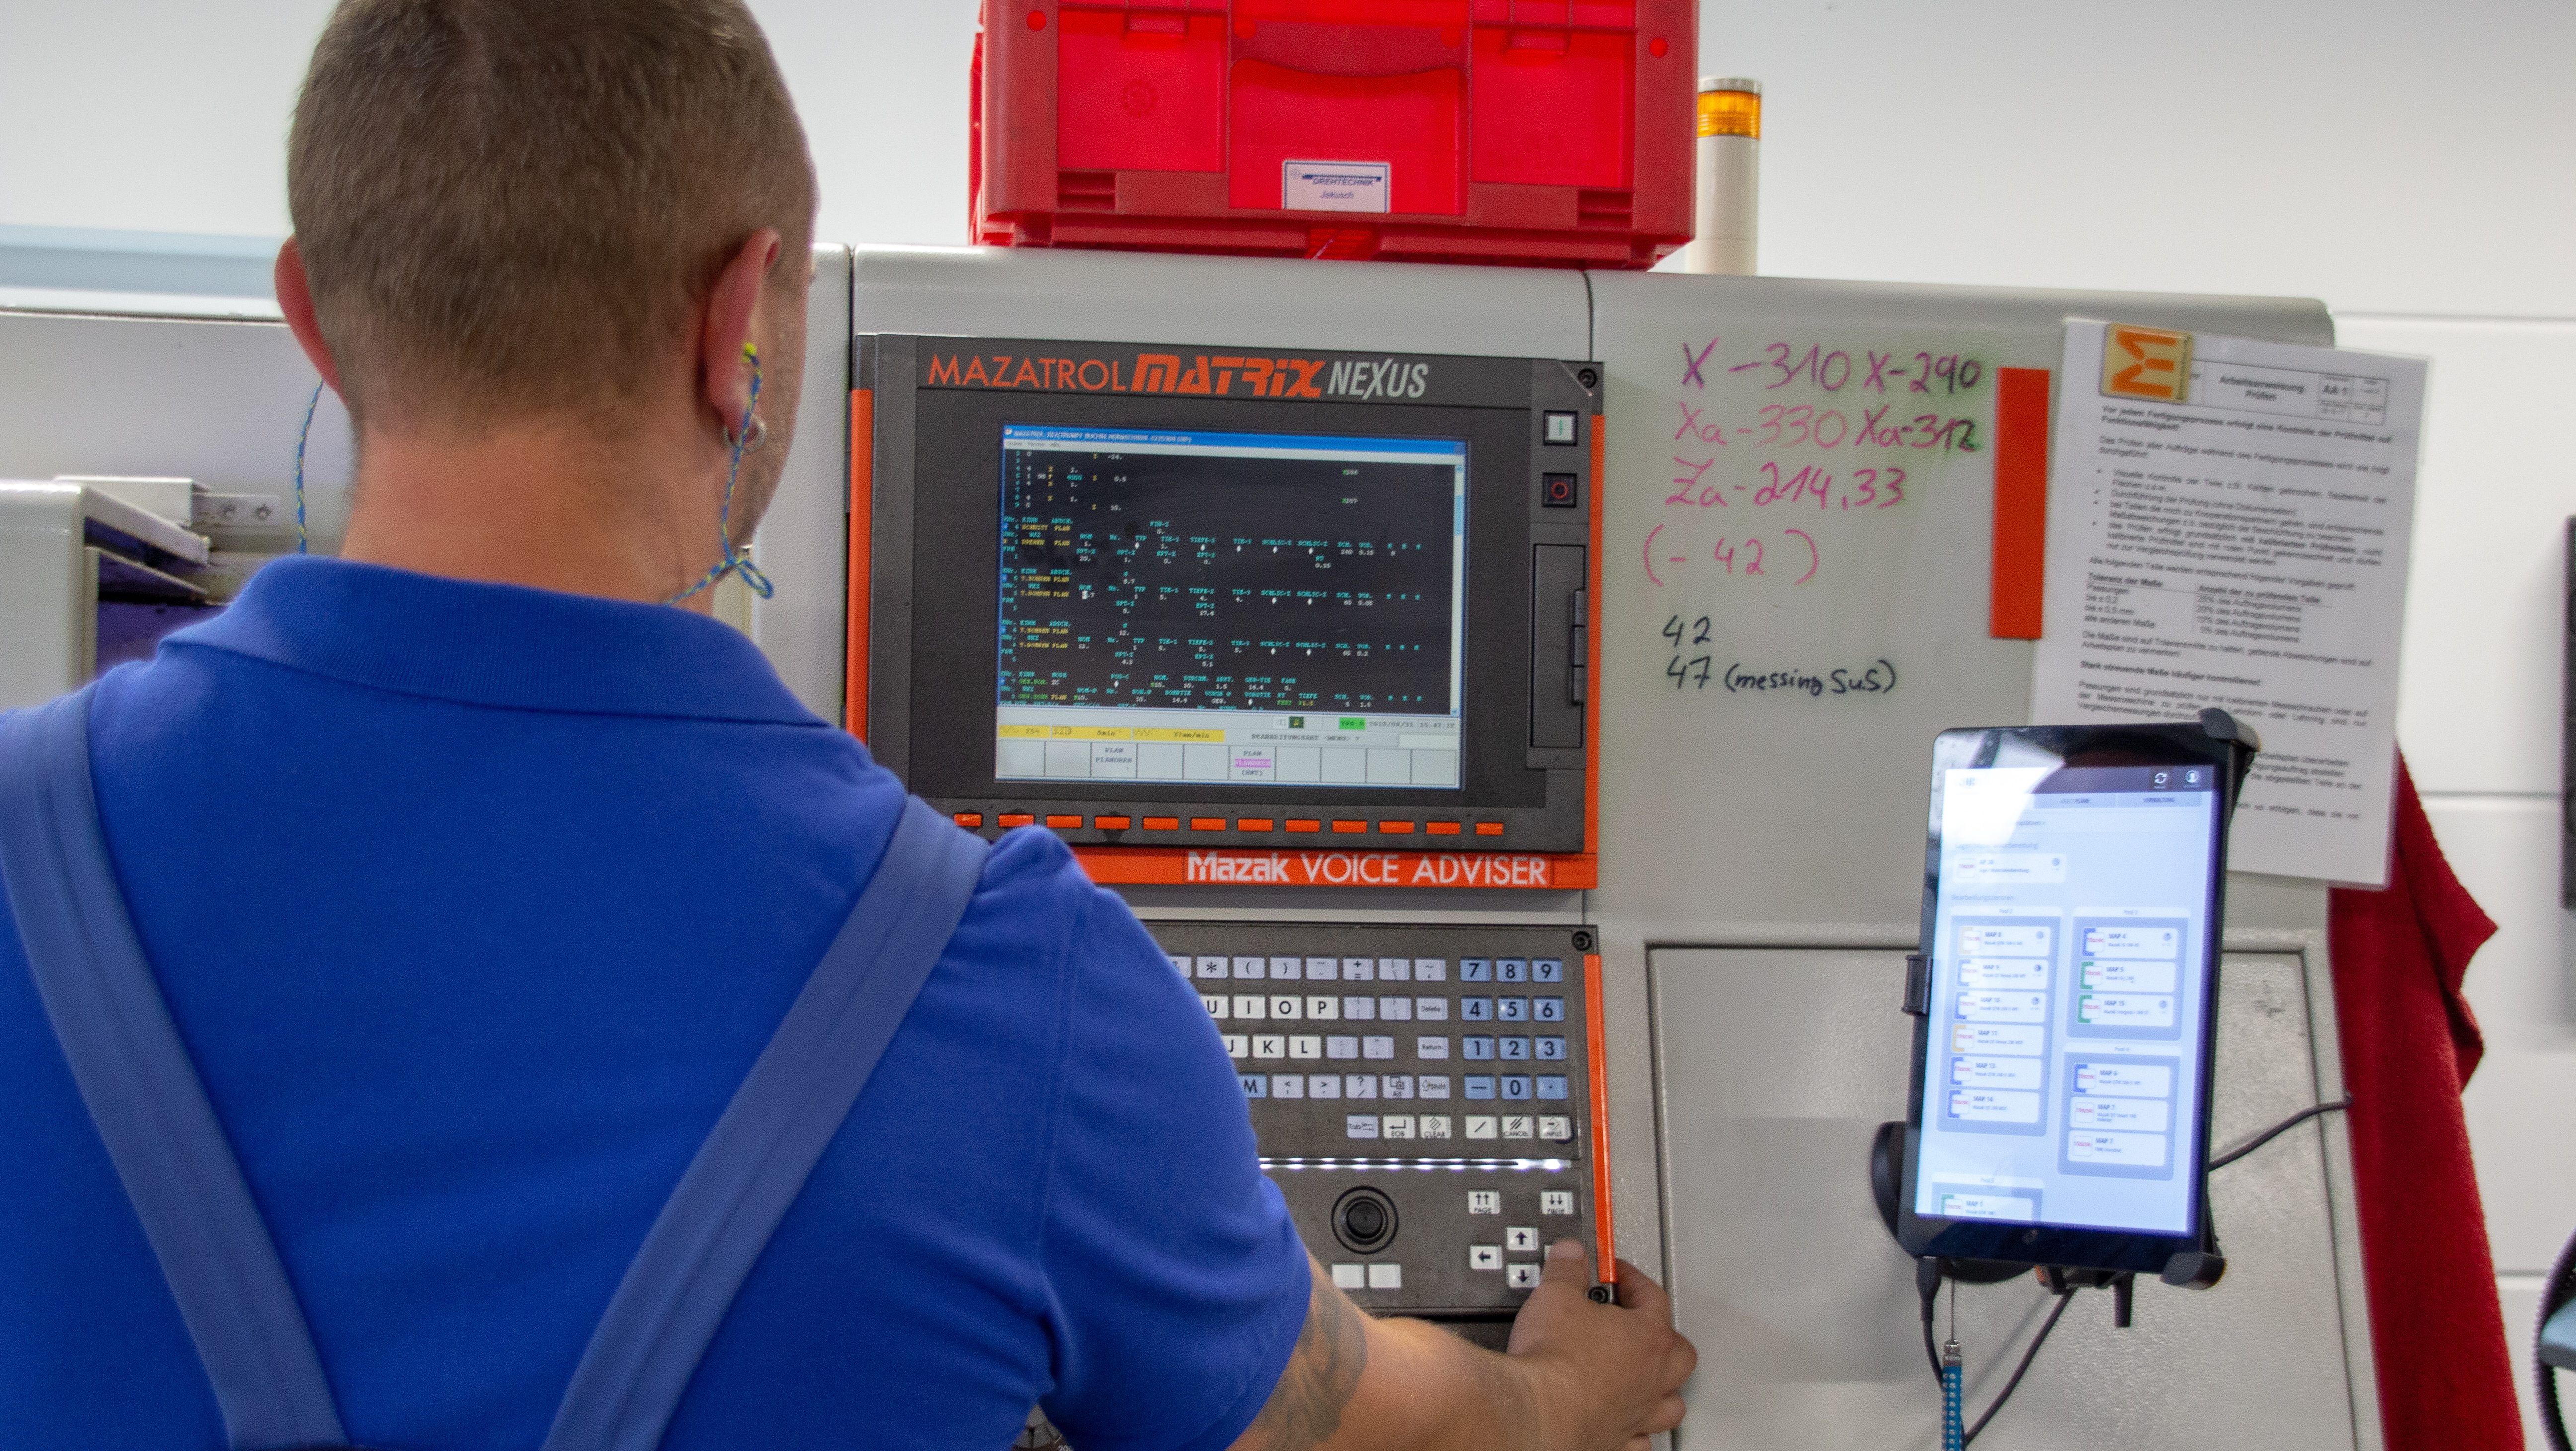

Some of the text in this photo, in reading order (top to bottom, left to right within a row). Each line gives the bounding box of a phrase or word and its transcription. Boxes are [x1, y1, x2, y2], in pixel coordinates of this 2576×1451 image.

[1681, 338, 1719, 389] X
[928, 354, 1126, 391] MAZATROL
[1327, 359, 1428, 399] NEXUS
[1662, 615, 1711, 646] 42
[1667, 655, 1711, 689] 47
[1188, 852, 1546, 886] Mazak VOICE ADVISER
[1469, 963, 1480, 978] 7
[1506, 964, 1515, 978] 8
[1541, 964, 1551, 979] 9
[1207, 1000, 1217, 1014] U
[1279, 1001, 1291, 1014] O
[1318, 1001, 1326, 1014] P
[1470, 1002, 1480, 1016] 4
[1507, 1002, 1517, 1017] 5
[1542, 1002, 1552, 1017] 6
[1228, 1040, 1234, 1052] J
[1264, 1040, 1273, 1053] K
[1301, 1041, 1308, 1054] L
[1474, 1041, 1480, 1055] 1
[1509, 1041, 1519, 1055] 2
[1545, 1041, 1554, 1056] 3
[1244, 1079, 1257, 1093] M
[1510, 1079, 1521, 1095] 0
